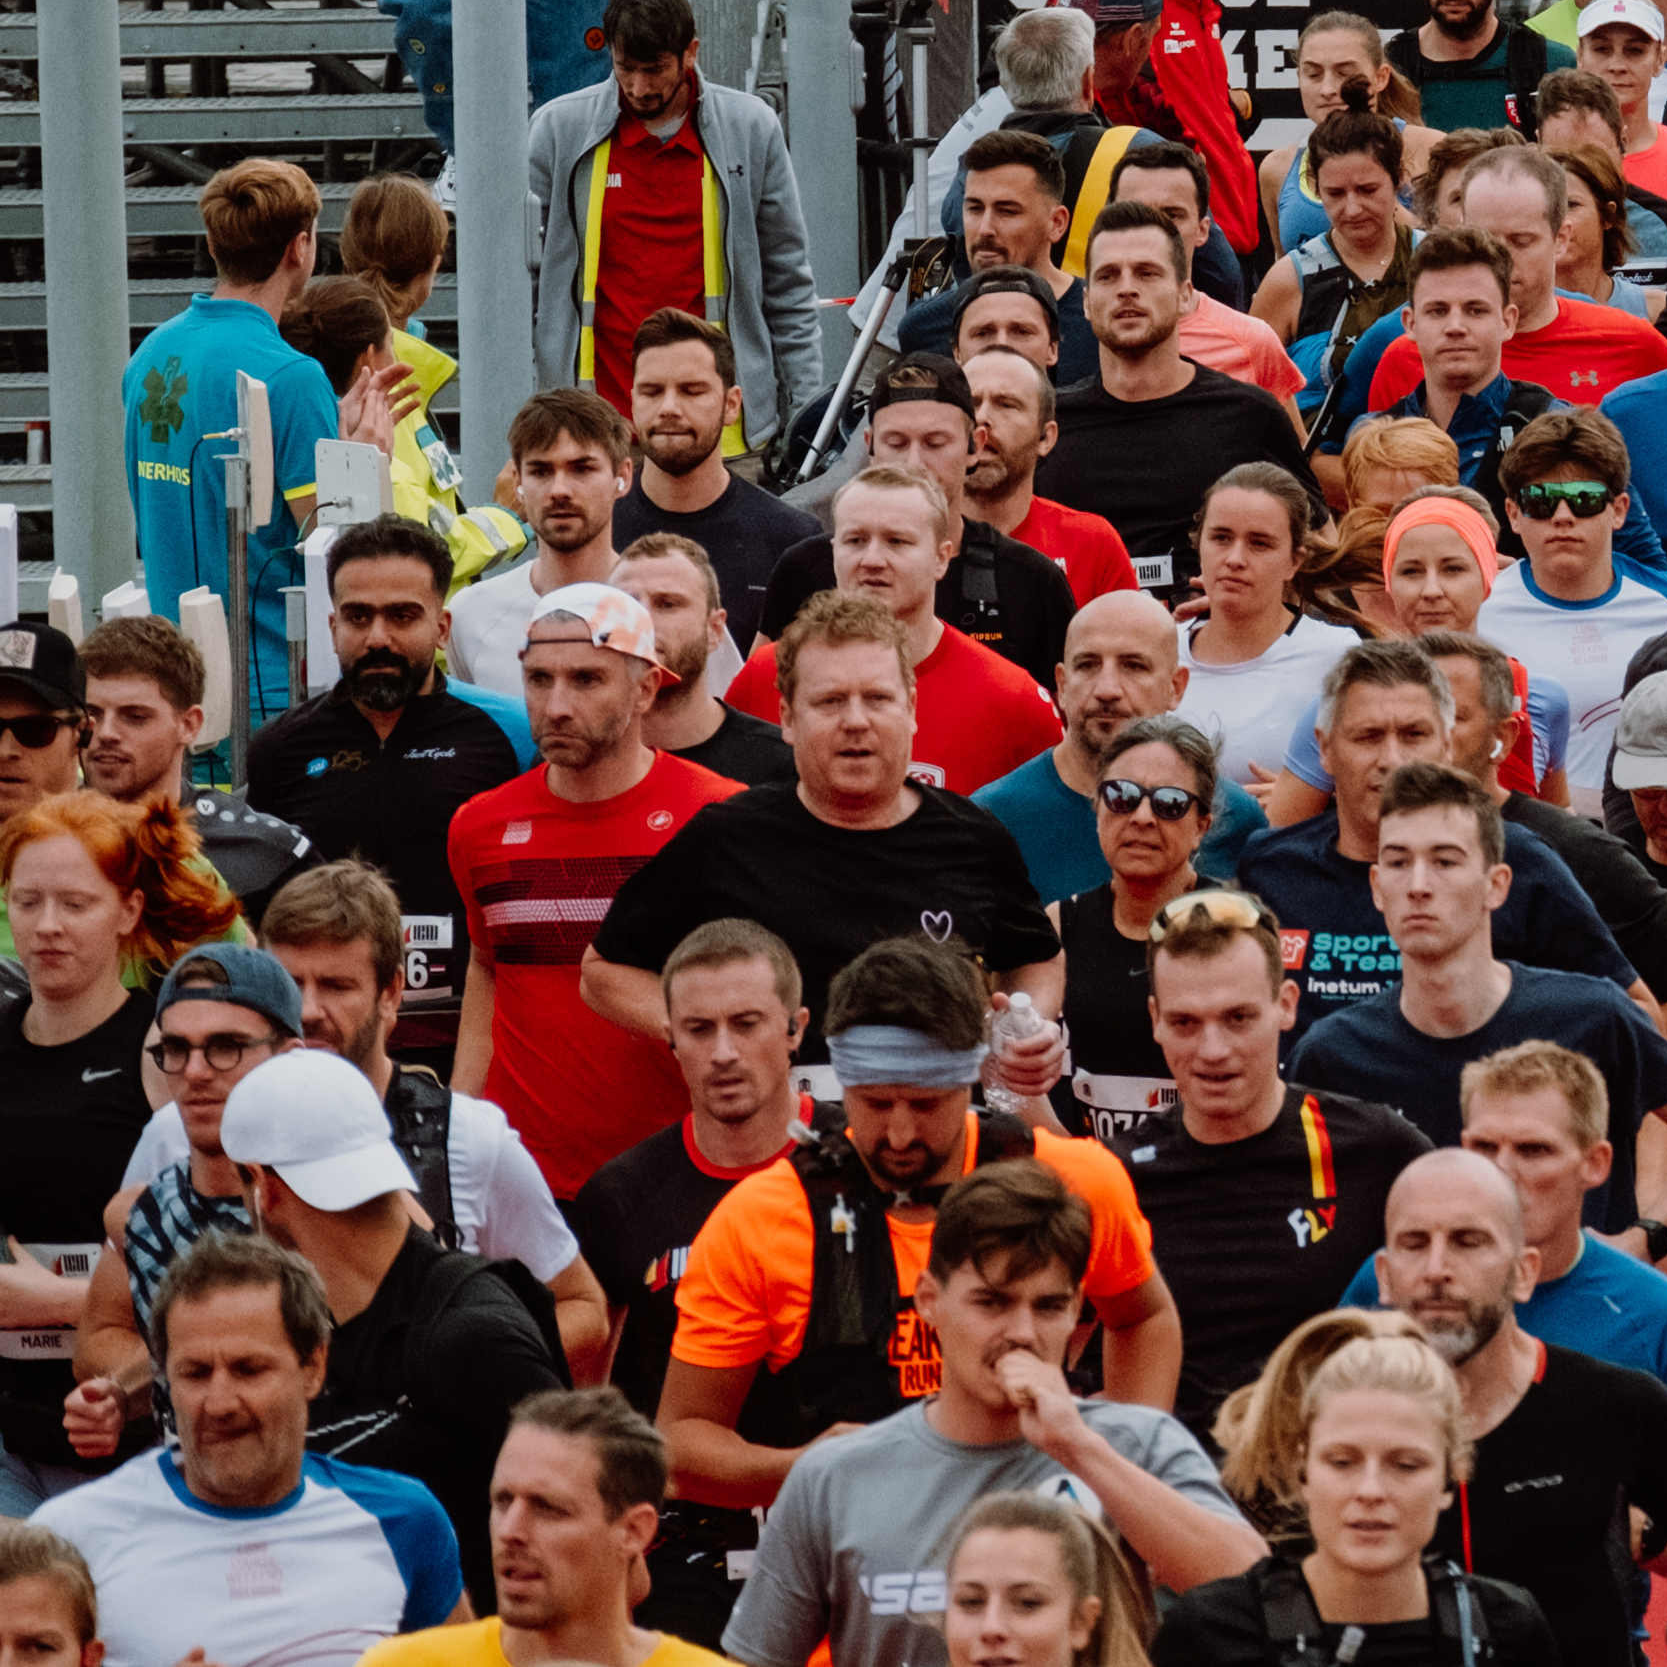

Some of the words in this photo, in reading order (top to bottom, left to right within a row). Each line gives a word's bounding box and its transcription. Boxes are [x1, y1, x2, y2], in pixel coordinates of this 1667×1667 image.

[1309, 953, 1336, 972] &
[1287, 1205, 1338, 1248] FLY
[21, 1333, 63, 1349] MARIE
